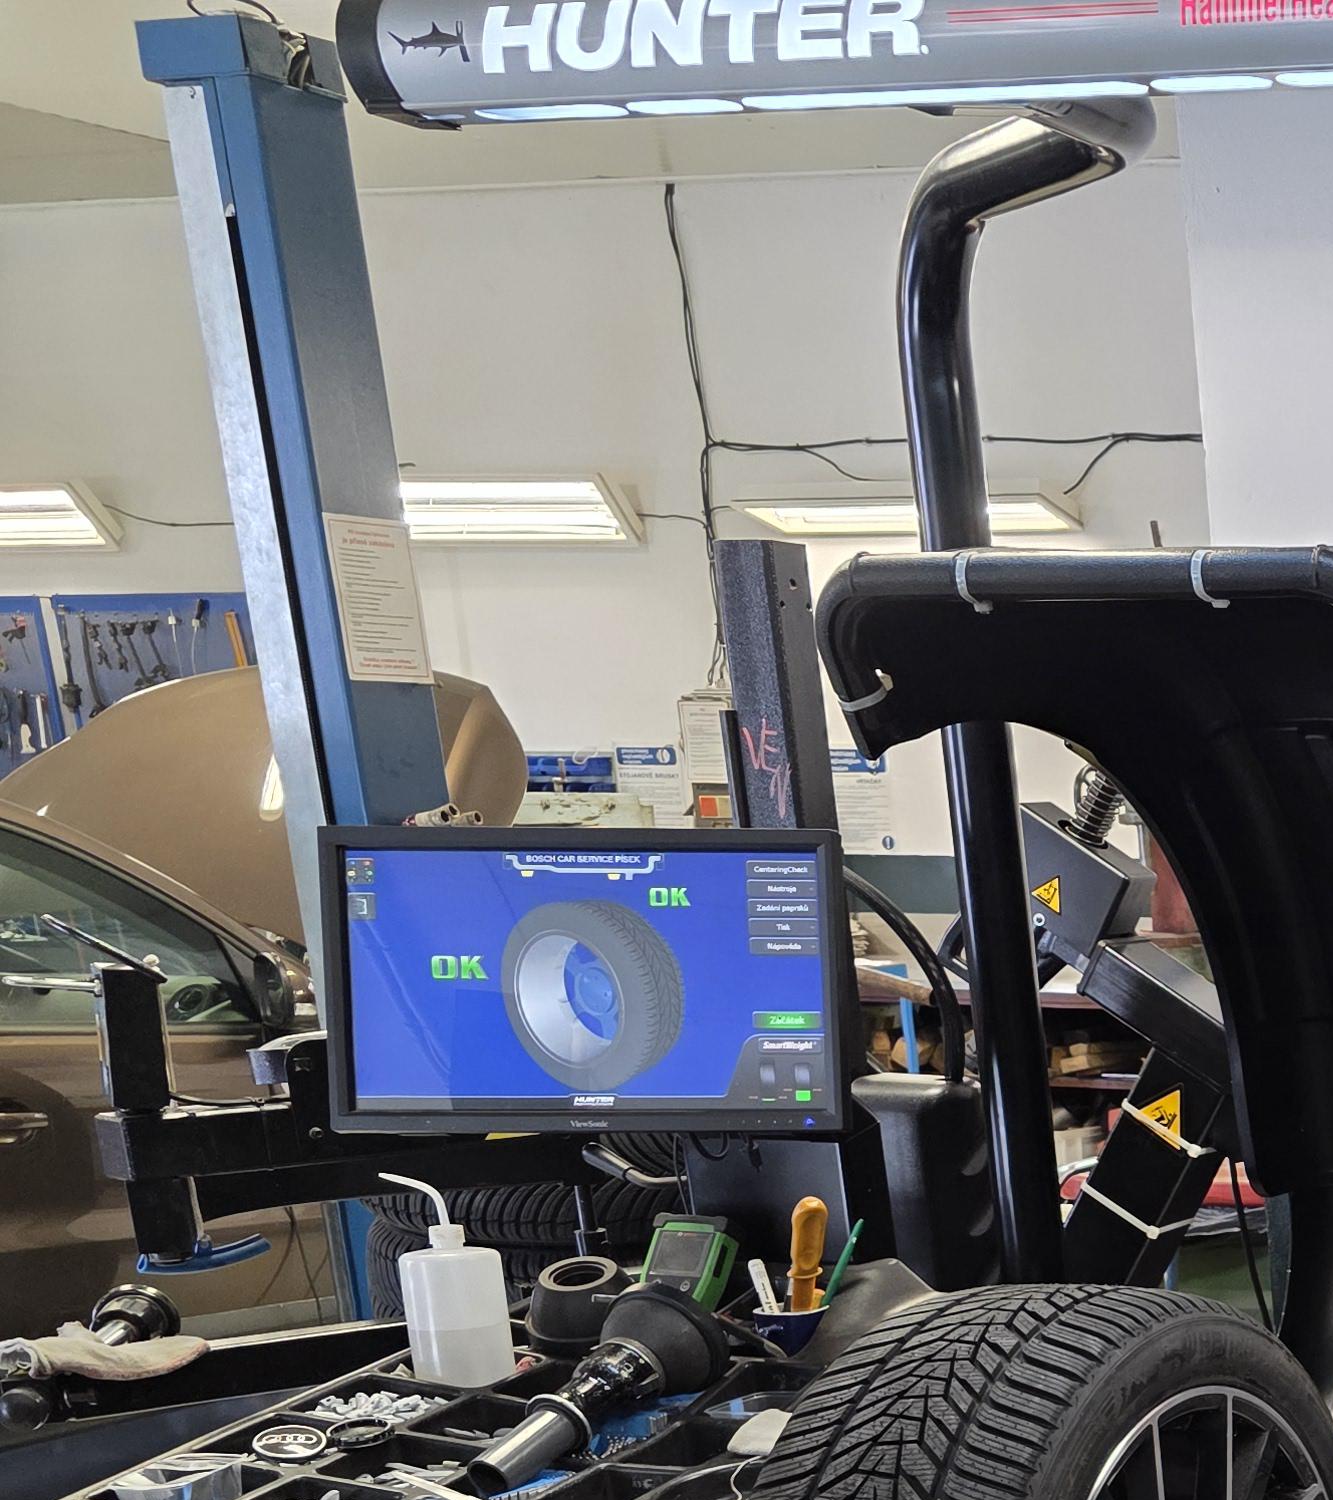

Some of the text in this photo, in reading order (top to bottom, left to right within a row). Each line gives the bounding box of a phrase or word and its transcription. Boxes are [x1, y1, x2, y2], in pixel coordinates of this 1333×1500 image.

[483, 0, 925, 73] HUNTER
[526, 855, 556, 863] BOSCH
[557, 855, 576, 863] CAR
[649, 887, 691, 907] OK
[431, 955, 488, 980] OK
